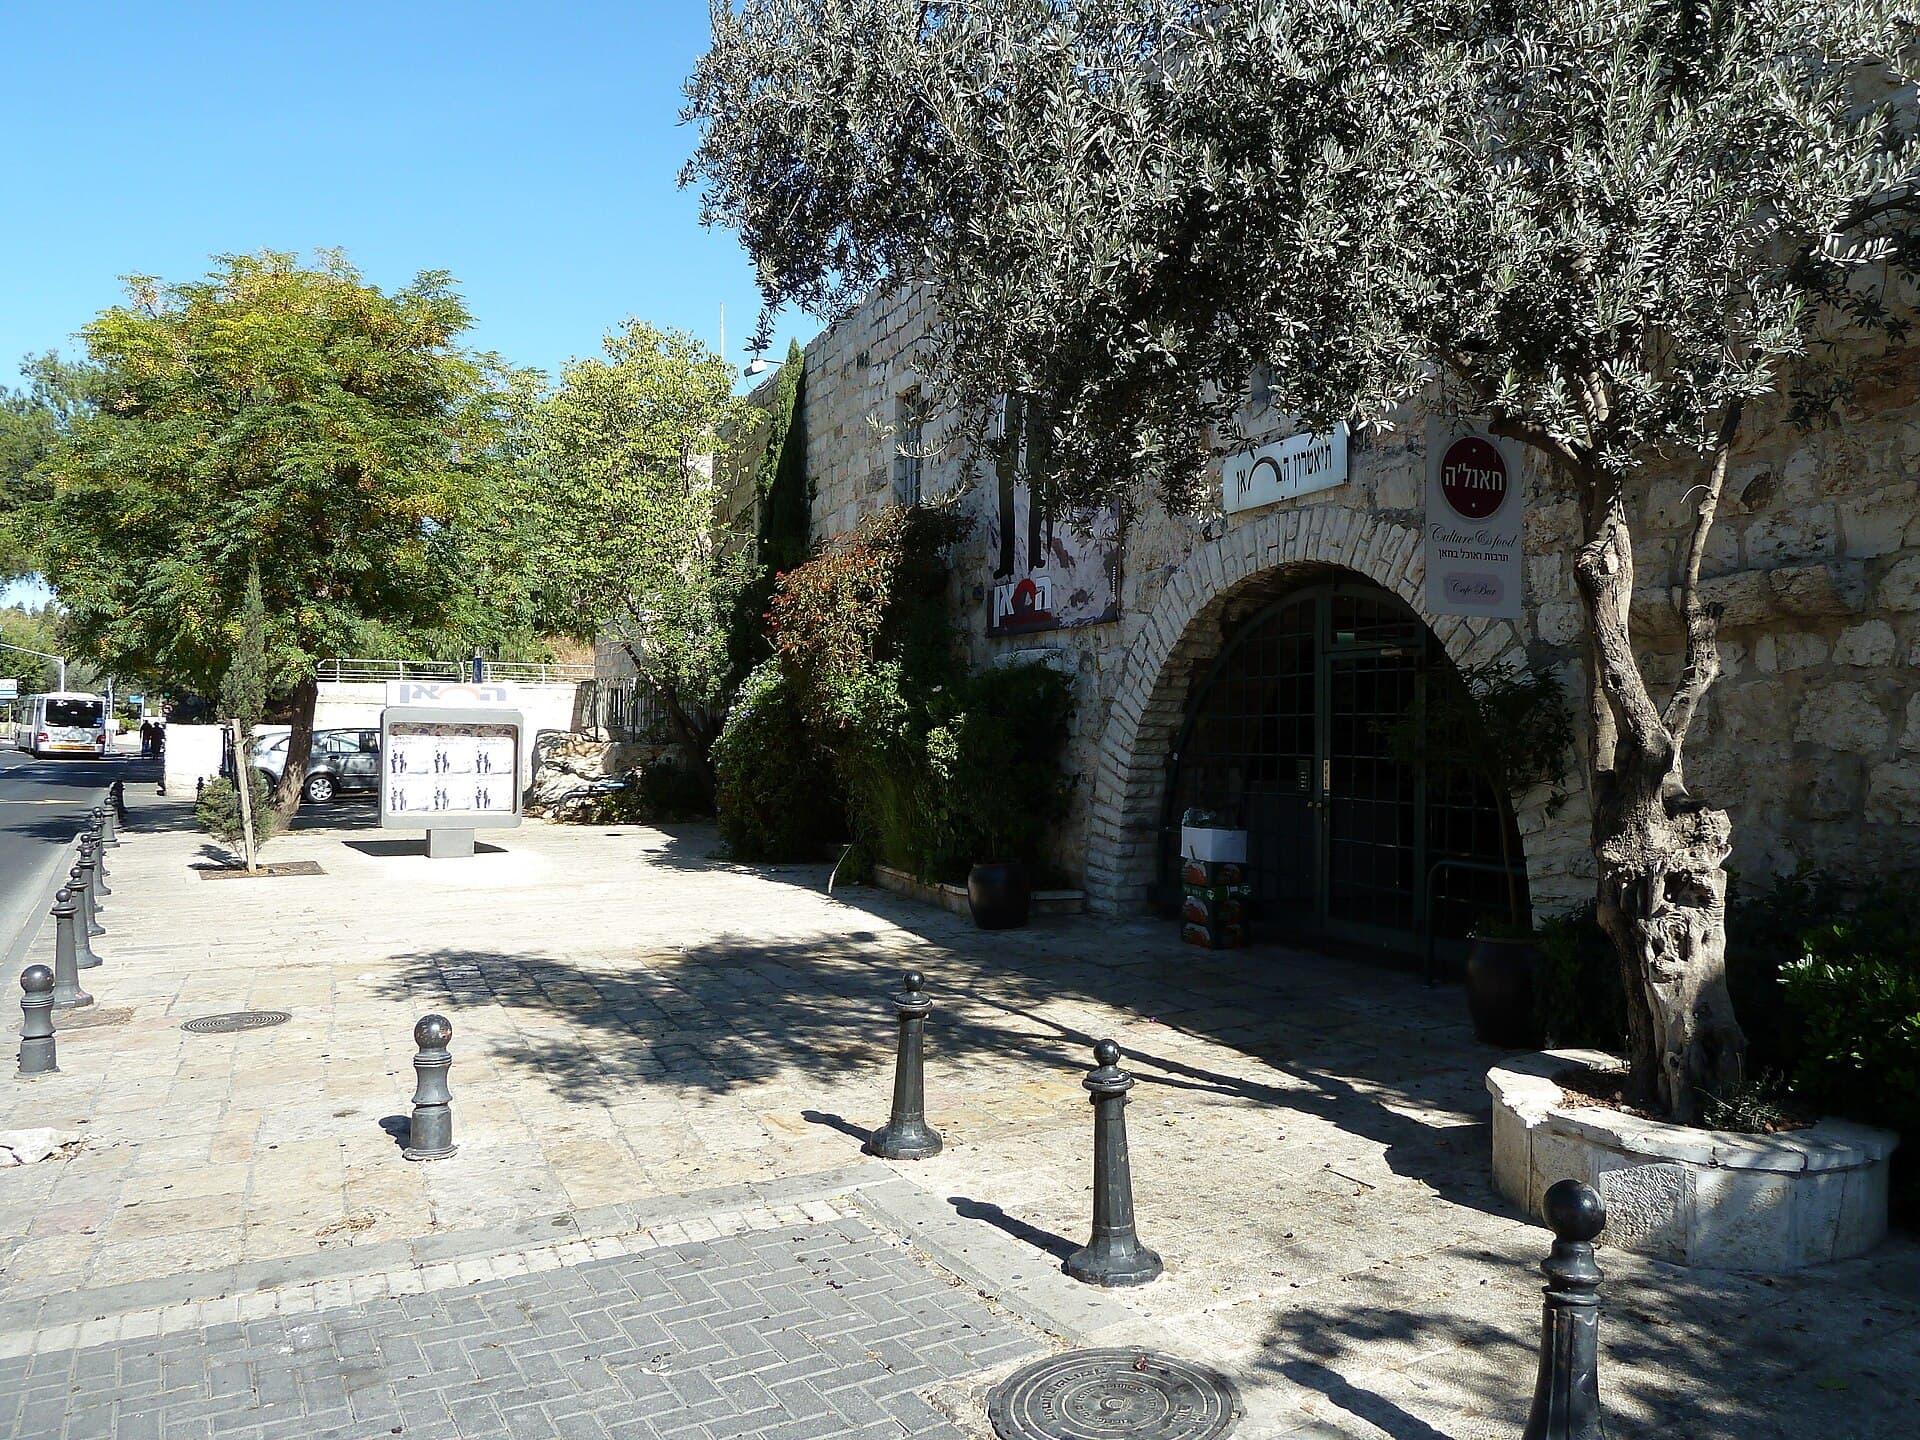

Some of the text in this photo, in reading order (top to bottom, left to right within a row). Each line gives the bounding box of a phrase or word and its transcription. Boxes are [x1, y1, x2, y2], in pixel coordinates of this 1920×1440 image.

[1293, 443, 1332, 488] תיאטרון
[1445, 462, 1503, 491] חאנל'ה
[1430, 522, 1474, 544] Culture
[1438, 547, 1509, 562] תרבות ואוכל בחאן
